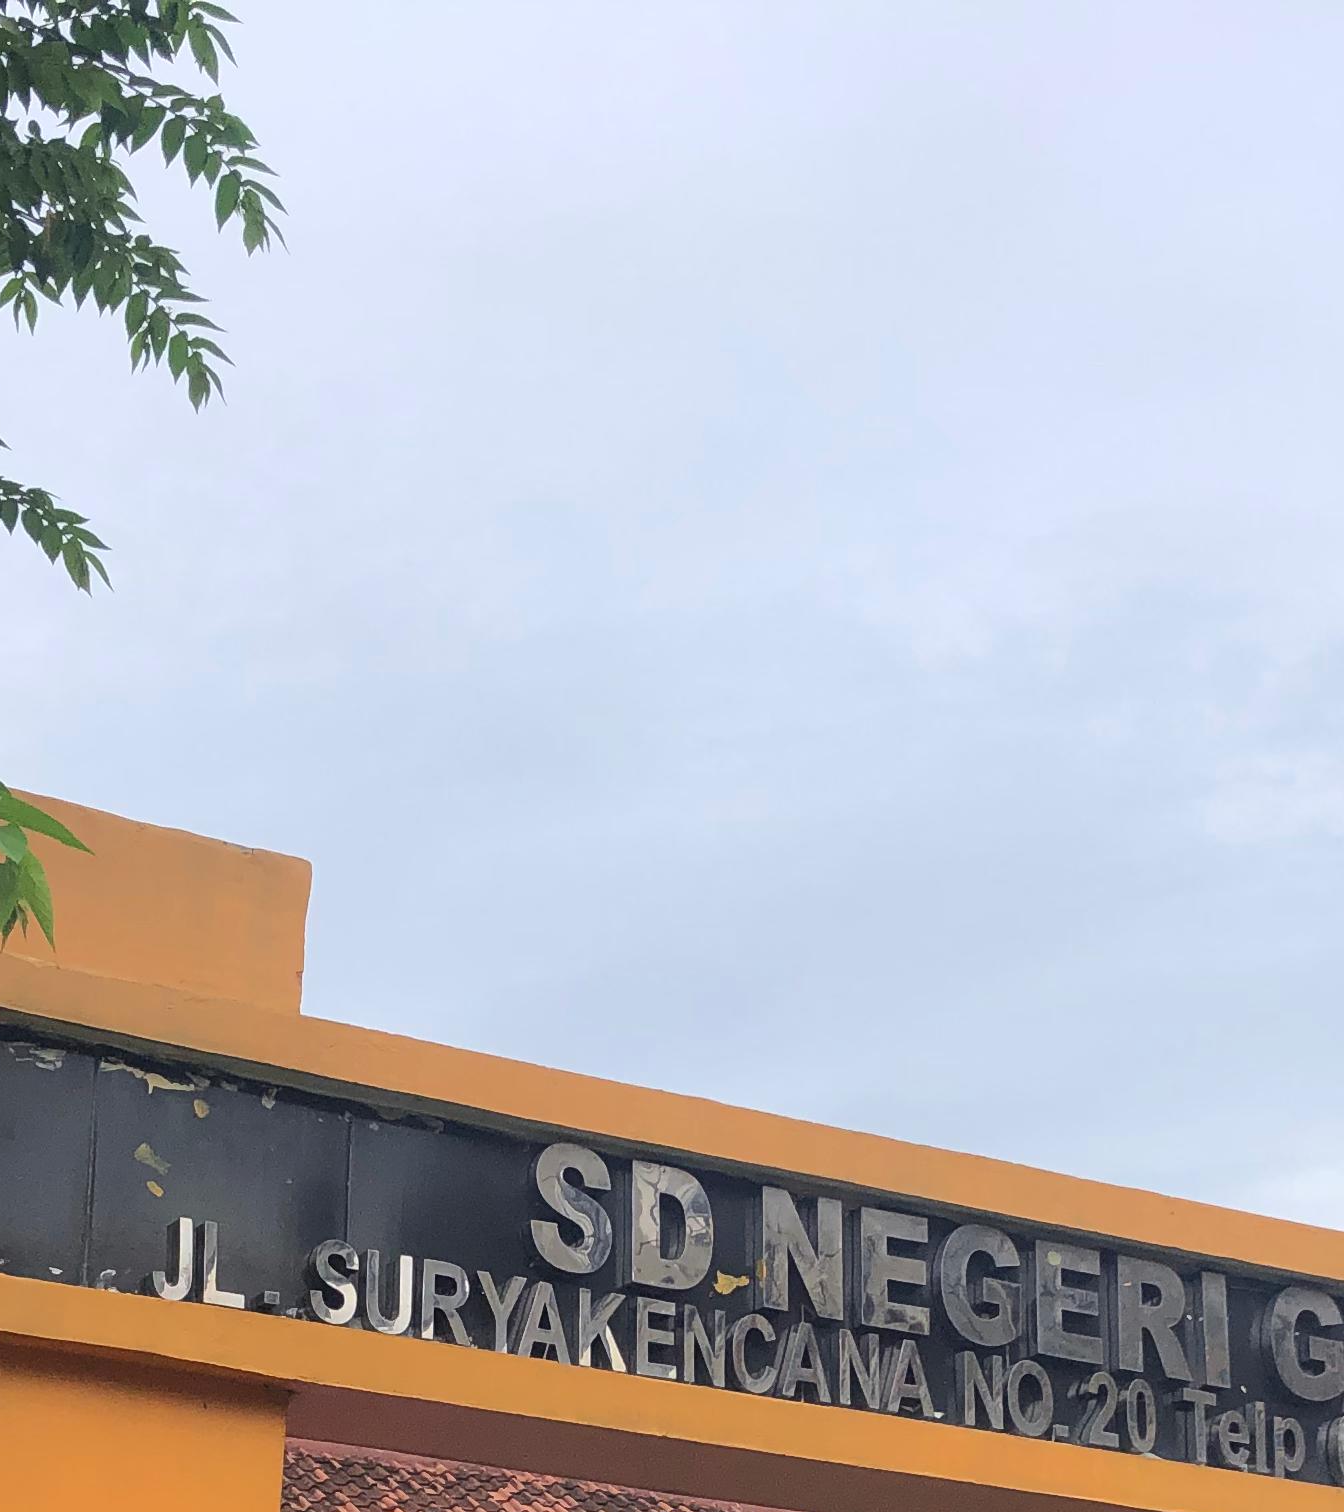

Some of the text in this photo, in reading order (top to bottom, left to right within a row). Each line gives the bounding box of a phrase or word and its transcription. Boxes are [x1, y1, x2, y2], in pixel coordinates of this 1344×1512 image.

[310, 1239, 935, 1418] SURYAKENCANA
[1088, 1371, 1156, 1453] 20
[1183, 1387, 1306, 1478] Telp
[531, 1141, 714, 1290] SD
[759, 1185, 1231, 1386] NEGERI
